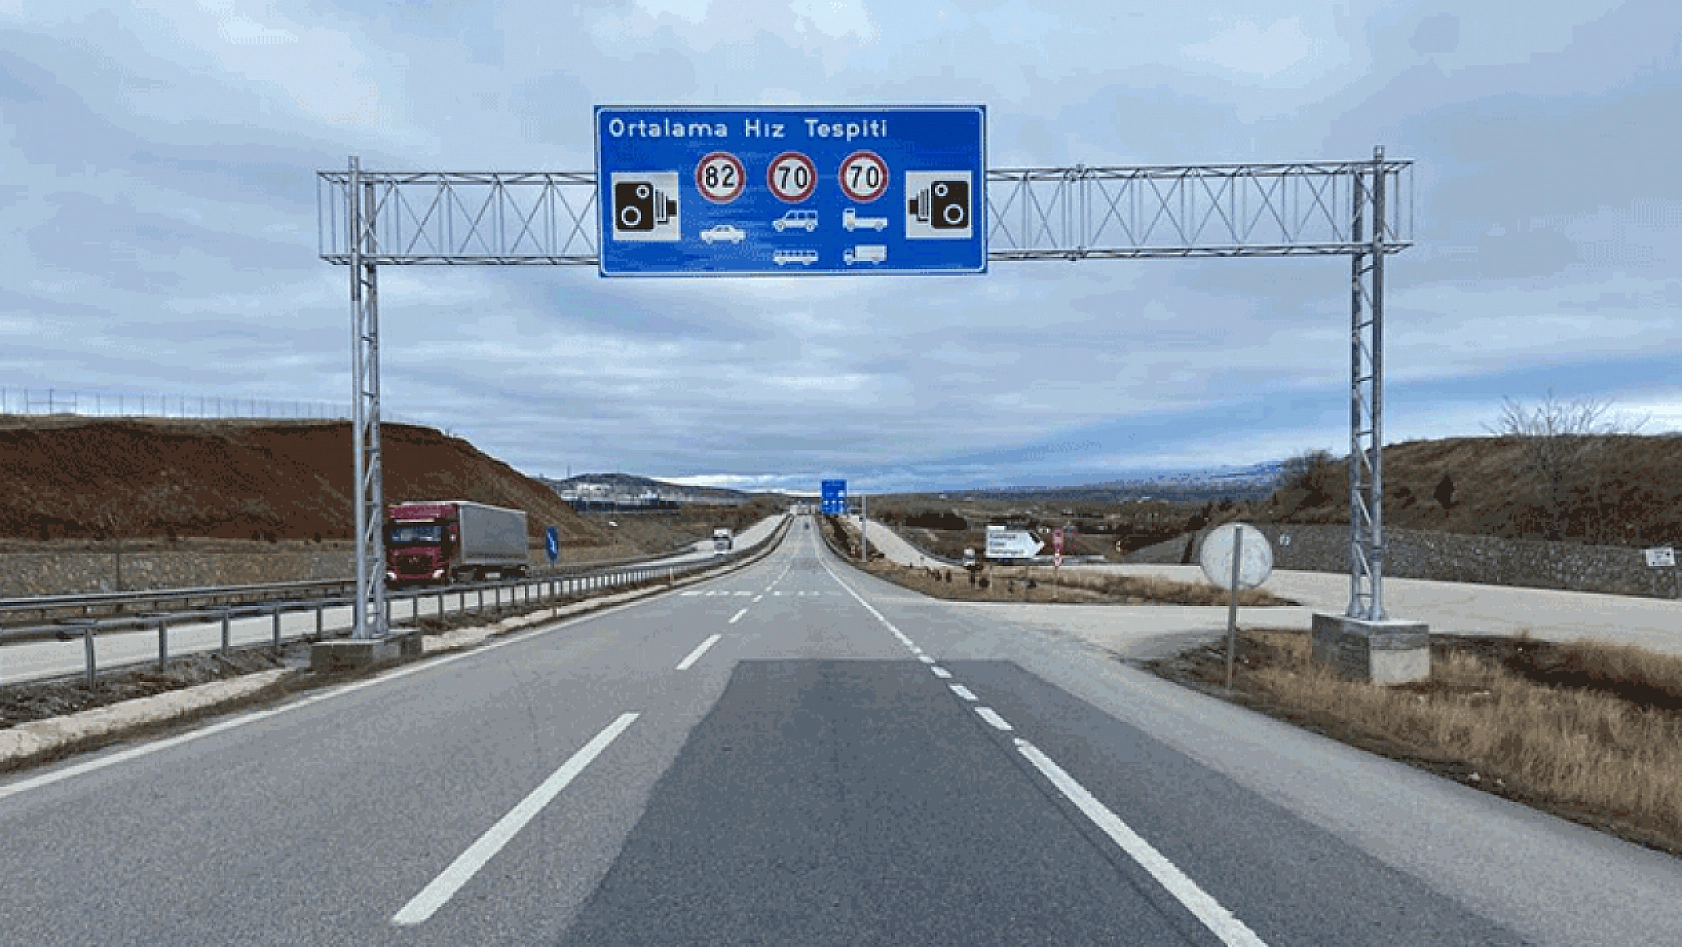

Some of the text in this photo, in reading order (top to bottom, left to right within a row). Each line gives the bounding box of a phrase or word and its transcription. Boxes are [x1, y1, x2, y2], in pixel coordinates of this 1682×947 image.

[608, 117, 888, 141] Ortalama Hız Tespiti
[705, 164, 735, 188] 82
[777, 165, 808, 189] 70
[850, 165, 879, 189] 70
